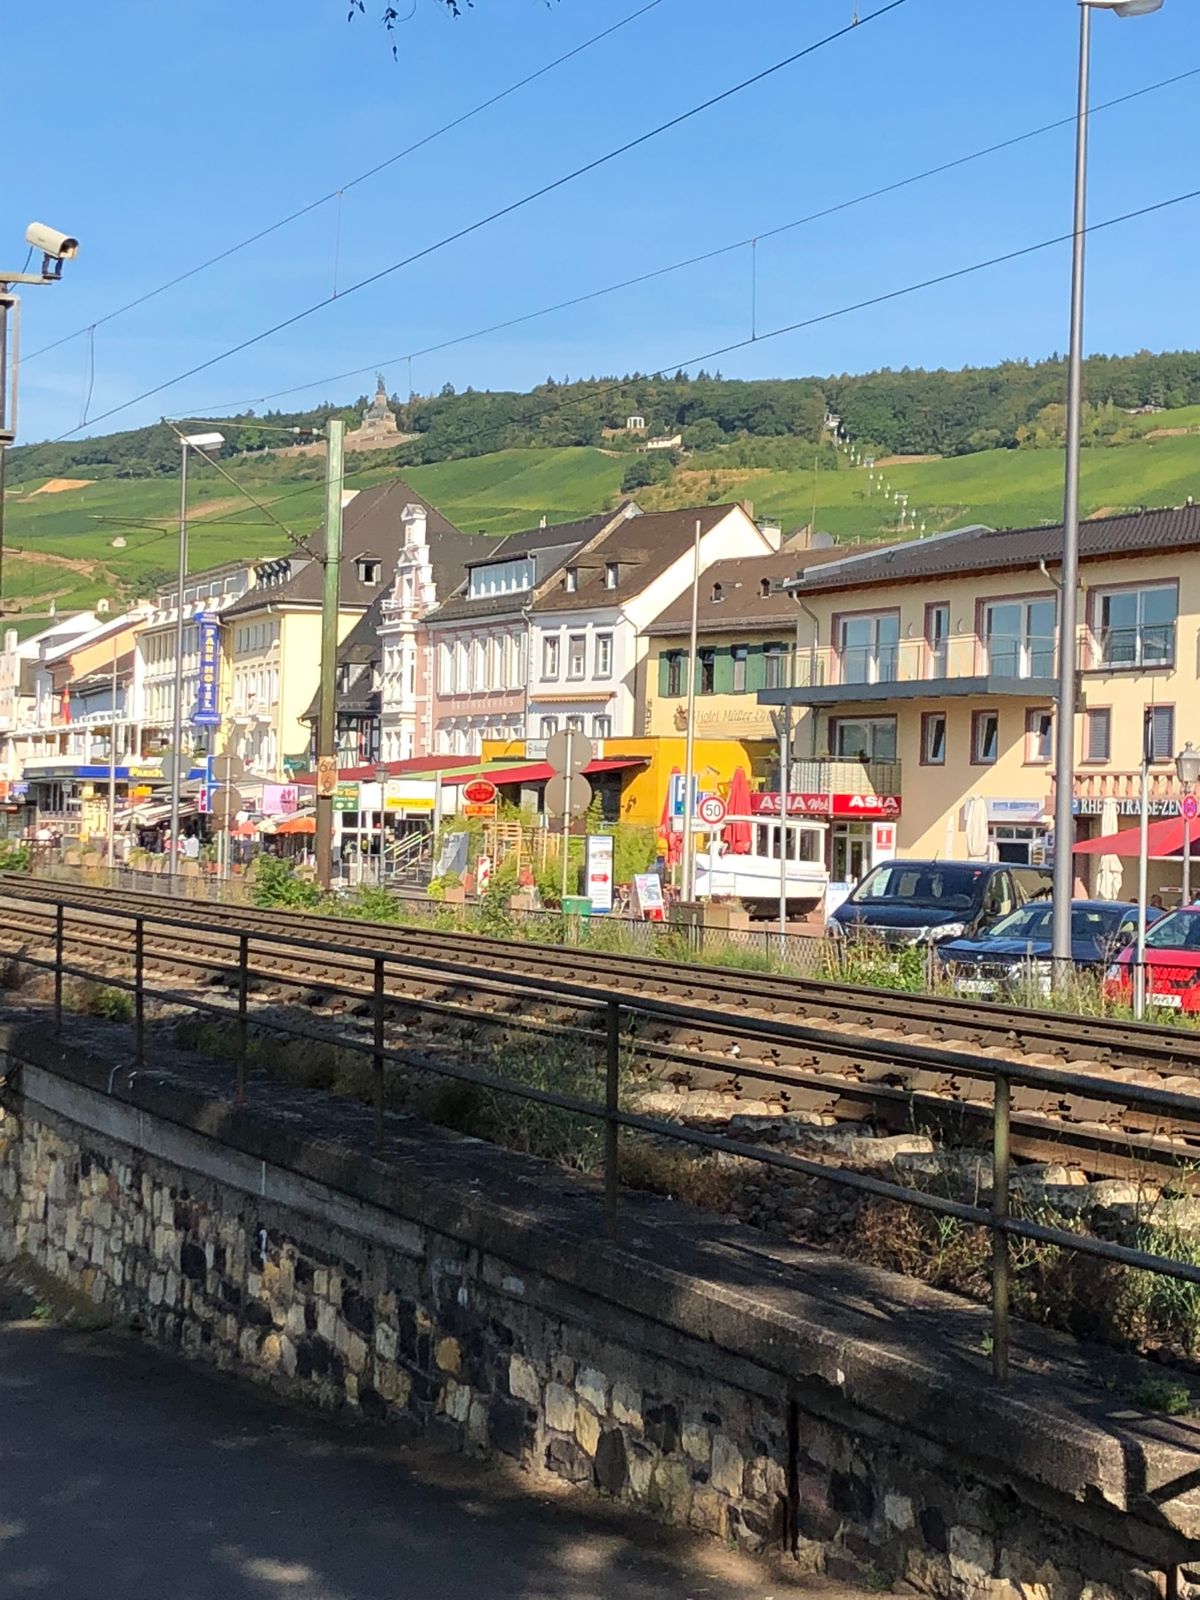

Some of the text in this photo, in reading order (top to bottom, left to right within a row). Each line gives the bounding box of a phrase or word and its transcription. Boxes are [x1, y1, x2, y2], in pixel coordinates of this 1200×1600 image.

[204, 628, 216, 663] PARK
[203, 665, 213, 708] HOTEL
[695, 708, 721, 723] Hotel
[319, 759, 338, 773] 64
[759, 796, 807, 811] ASIA
[848, 796, 899, 808] ASIA
[705, 804, 721, 817] 50
